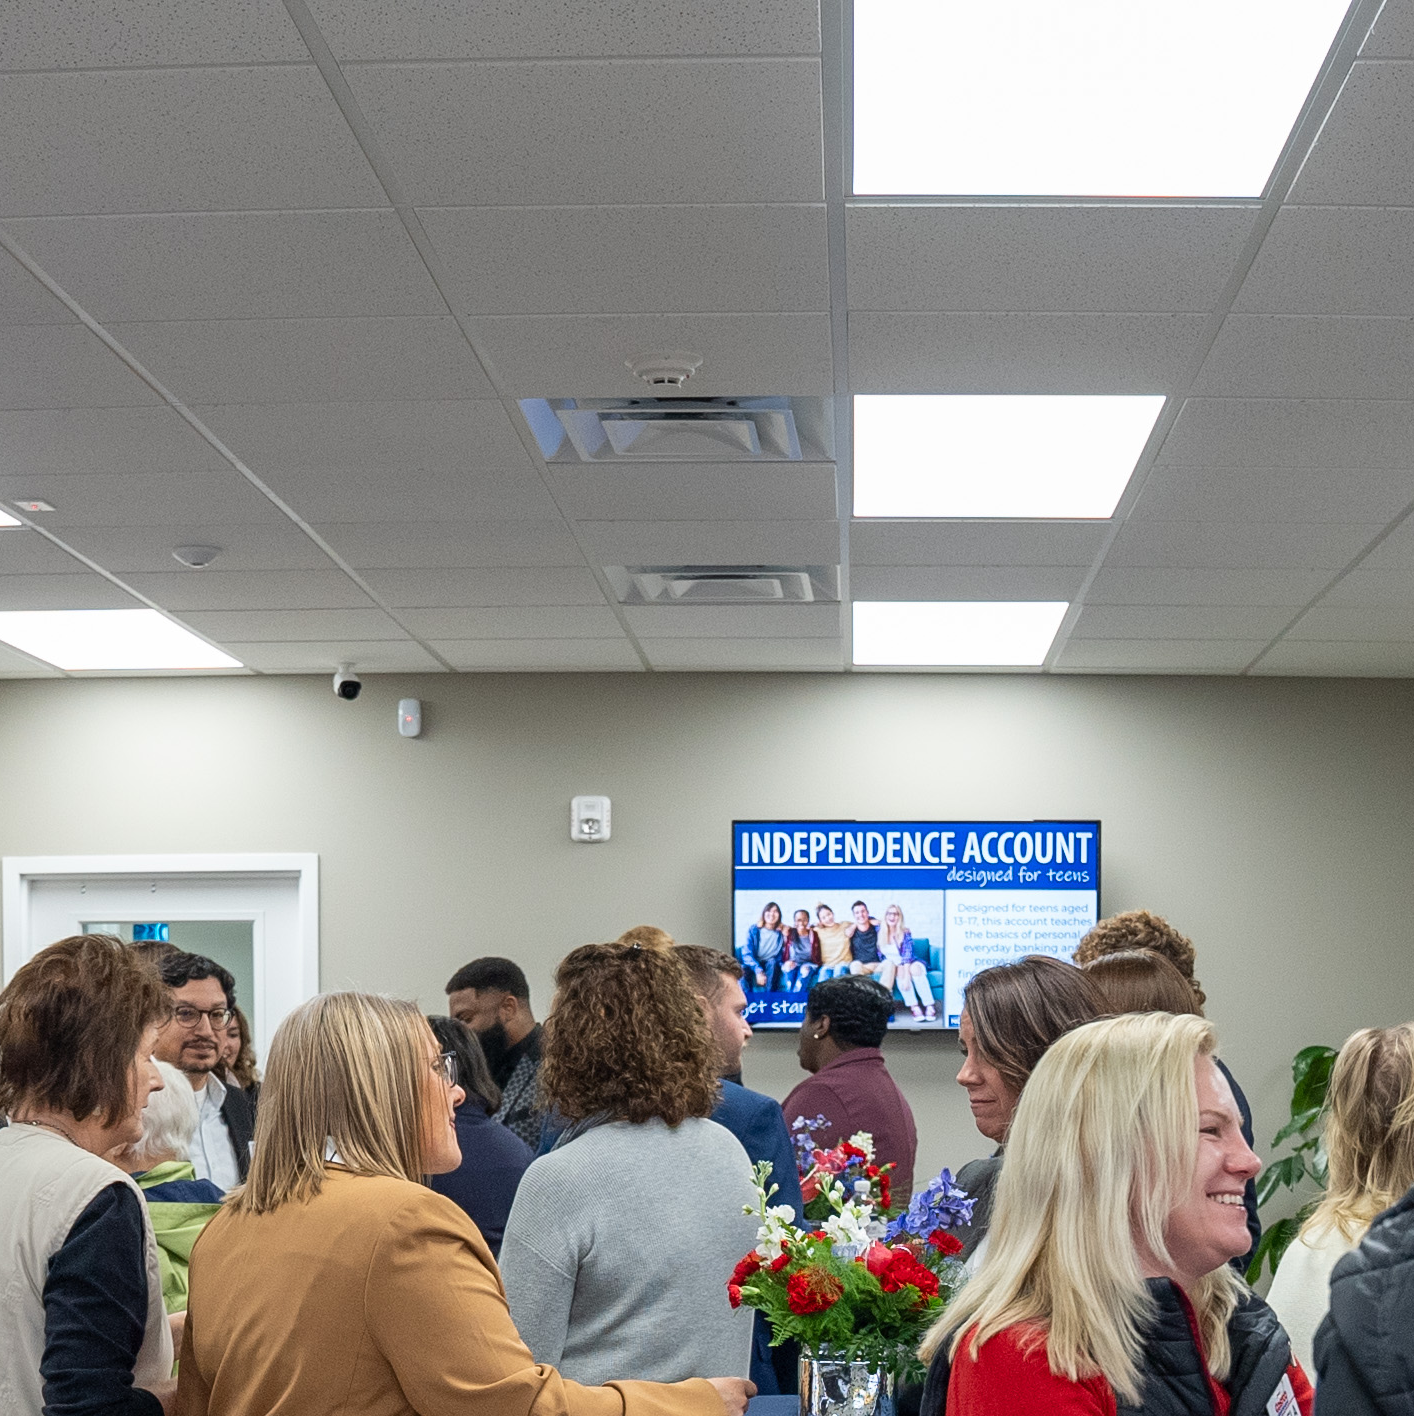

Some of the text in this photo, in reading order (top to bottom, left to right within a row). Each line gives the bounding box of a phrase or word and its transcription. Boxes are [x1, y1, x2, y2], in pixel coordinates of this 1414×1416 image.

[741, 831, 1093, 864] INDEPENDENCE ACCOUNT
[946, 866, 1090, 887] designed for teens
[957, 903, 1089, 916] Designed for teens aged
[954, 916, 1092, 927] 13-17, this account teaches
[965, 929, 1081, 942] the basics of personal
[963, 944, 1011, 955] everyday
[1014, 943, 1058, 955] banking
[771, 999, 808, 1015] star
